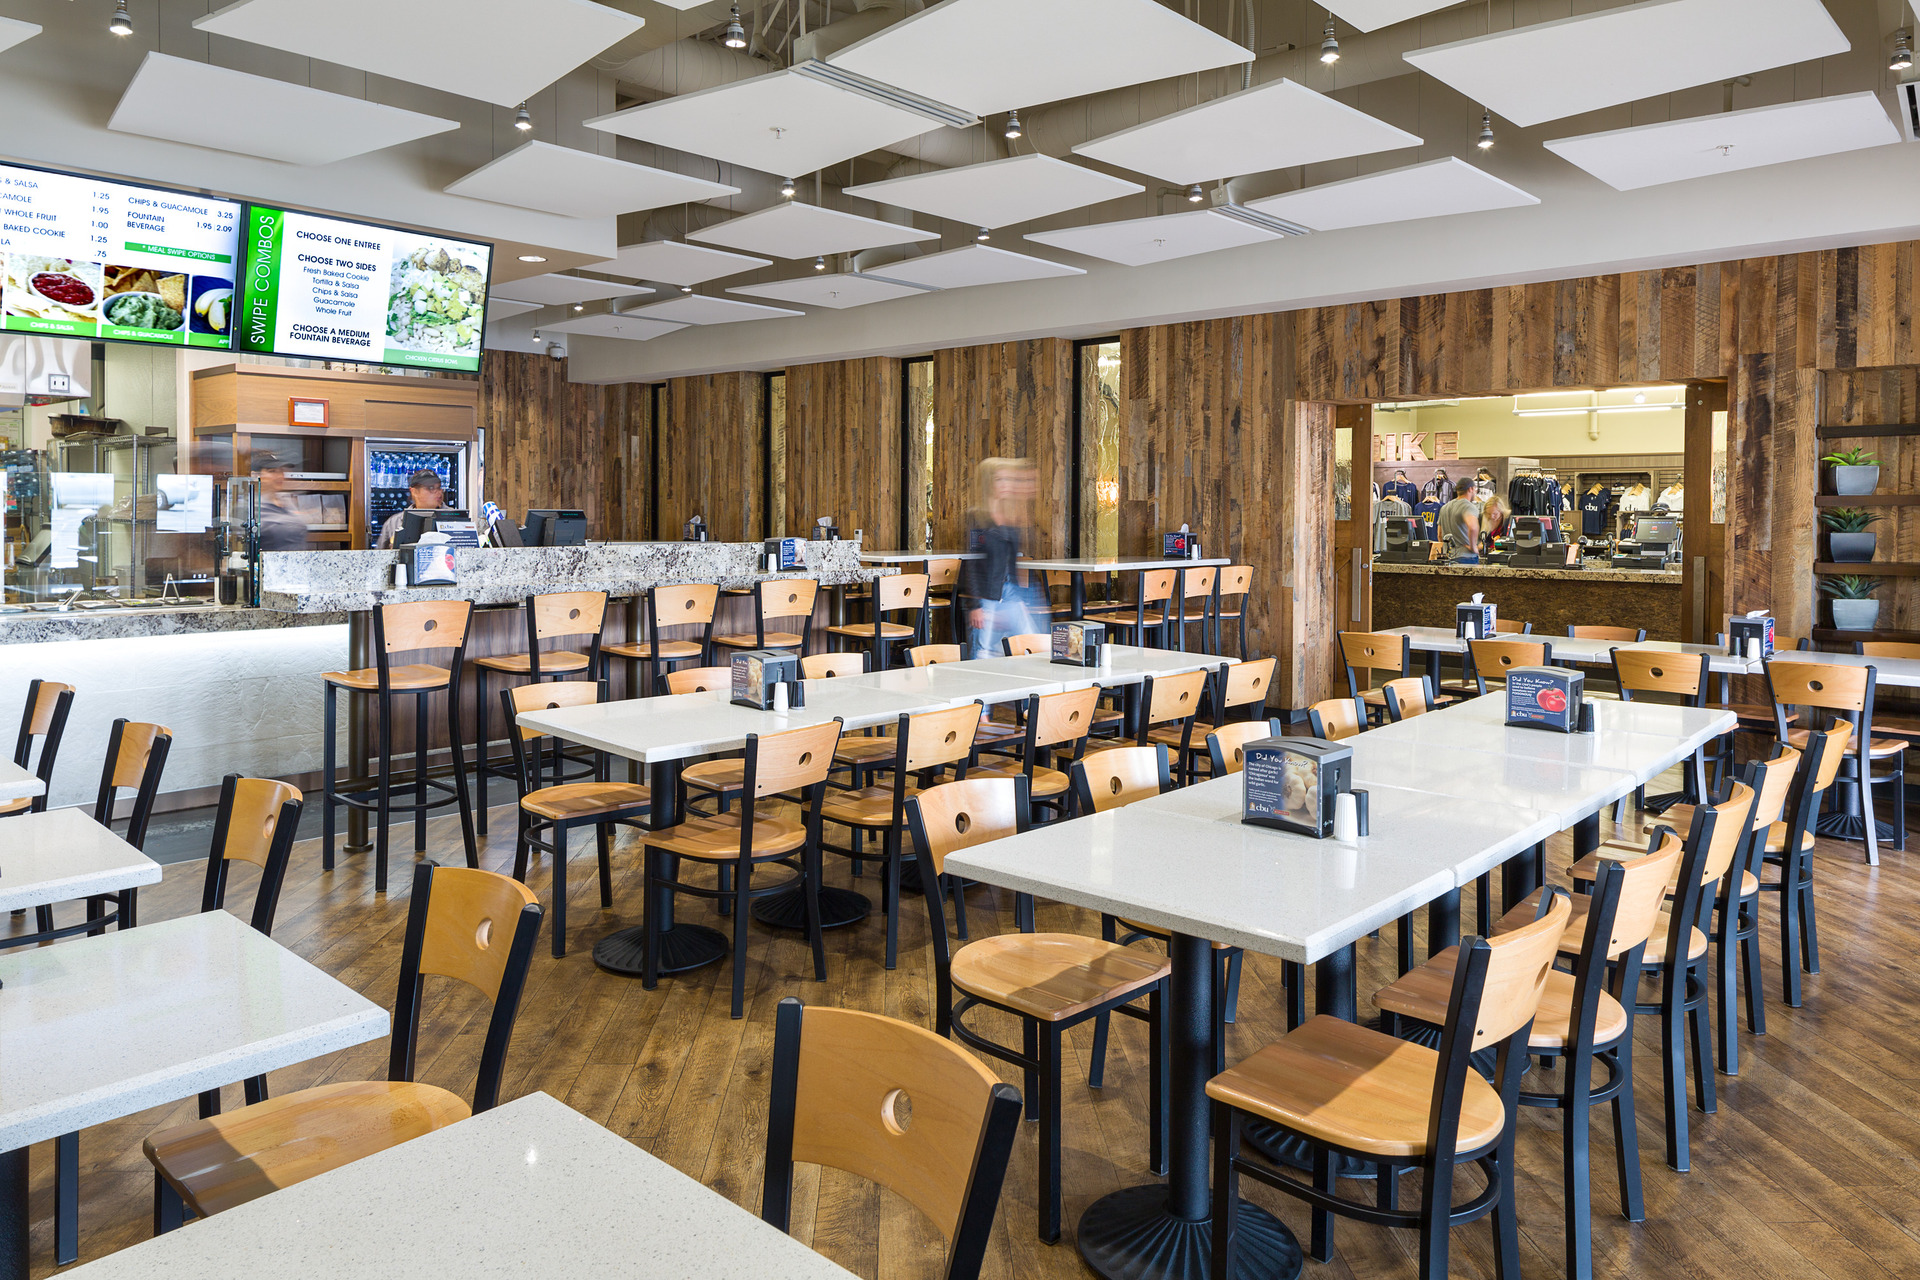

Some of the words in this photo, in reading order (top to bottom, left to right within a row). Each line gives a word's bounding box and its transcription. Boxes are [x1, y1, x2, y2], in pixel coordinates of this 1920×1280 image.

[14, 179, 38, 188] SALSA
[94, 192, 110, 200] 1.25
[93, 206, 109, 214] 1.95
[128, 197, 150, 206] CHIPS
[161, 202, 208, 215] GUACAMOLE
[217, 211, 233, 219] 3.25
[4, 208, 33, 218] WHOLE
[37, 213, 56, 221] FRUIT
[92, 221, 108, 229] 1.00
[128, 212, 164, 222] FOUNTAIN
[127, 221, 165, 232] BEVERAGE
[4, 224, 30, 233] BAKED
[33, 228, 65, 238] COOKIE
[91, 235, 107, 243] 1.25
[296, 231, 332, 242] CHOOSE
[335, 237, 351, 246] ONE
[354, 240, 380, 250] ENTREE
[167, 248, 186, 256] SWIPE
[188, 251, 215, 260] OPTIONS
[254, 215, 274, 292] COMBOS
[298, 254, 333, 265] CHOOSE
[336, 259, 353, 268] TWO
[356, 262, 376, 272] SIDES
[304, 266, 321, 274] Fresh
[323, 269, 344, 278] Baked
[346, 272, 369, 281] Cookie
[312, 277, 333, 286] Tortilla
[342, 281, 359, 289] Salsa
[312, 286, 332, 295] Chips
[340, 290, 358, 299] Salsa
[313, 296, 355, 307] Guacamole
[316, 306, 337, 315] Whole
[251, 298, 267, 344] SWIPE
[137, 331, 174, 340] GUACAMOLE
[293, 324, 328, 334] CHOOSE
[338, 329, 369, 338] MEDIUM
[290, 332, 330, 342] FOUNTAIN
[332, 336, 371, 347] BEVERAGE
[1585, 503, 1598, 511] cbu
[1422, 512, 1435, 523] CBU
[1270, 755, 1282, 763] You
[1256, 804, 1269, 812] cbu
